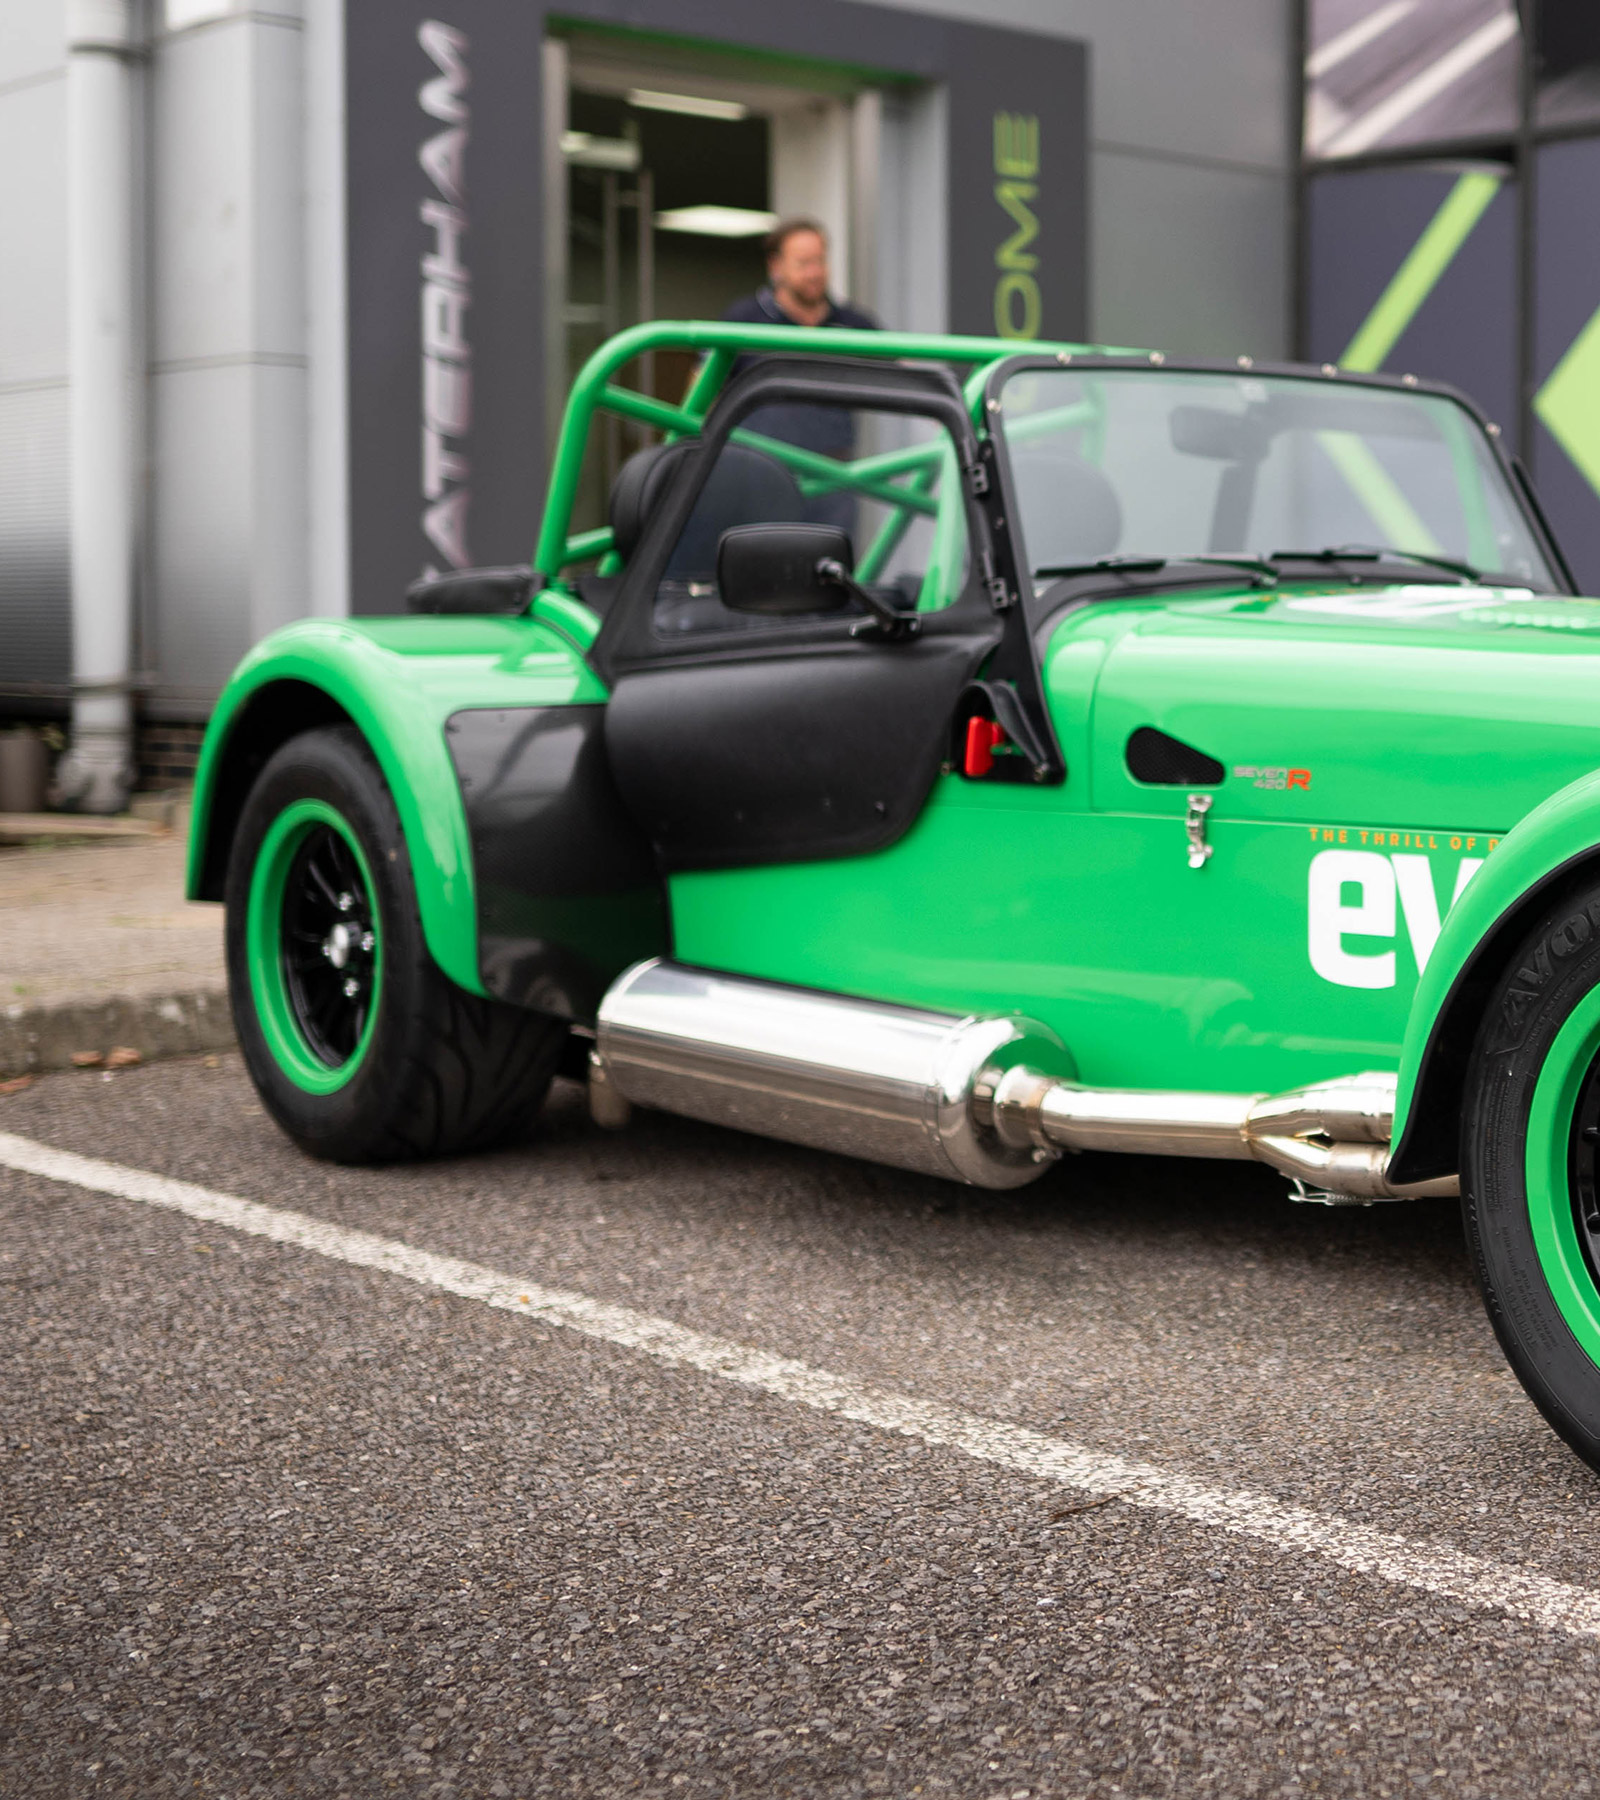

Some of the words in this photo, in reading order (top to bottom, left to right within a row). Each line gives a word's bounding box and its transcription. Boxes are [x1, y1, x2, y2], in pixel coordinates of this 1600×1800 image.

[417, 17, 474, 582] ATERHAM
[1309, 827, 1348, 843] THE
[1360, 830, 1438, 850] THRILL
[1451, 836, 1476, 850] OF
